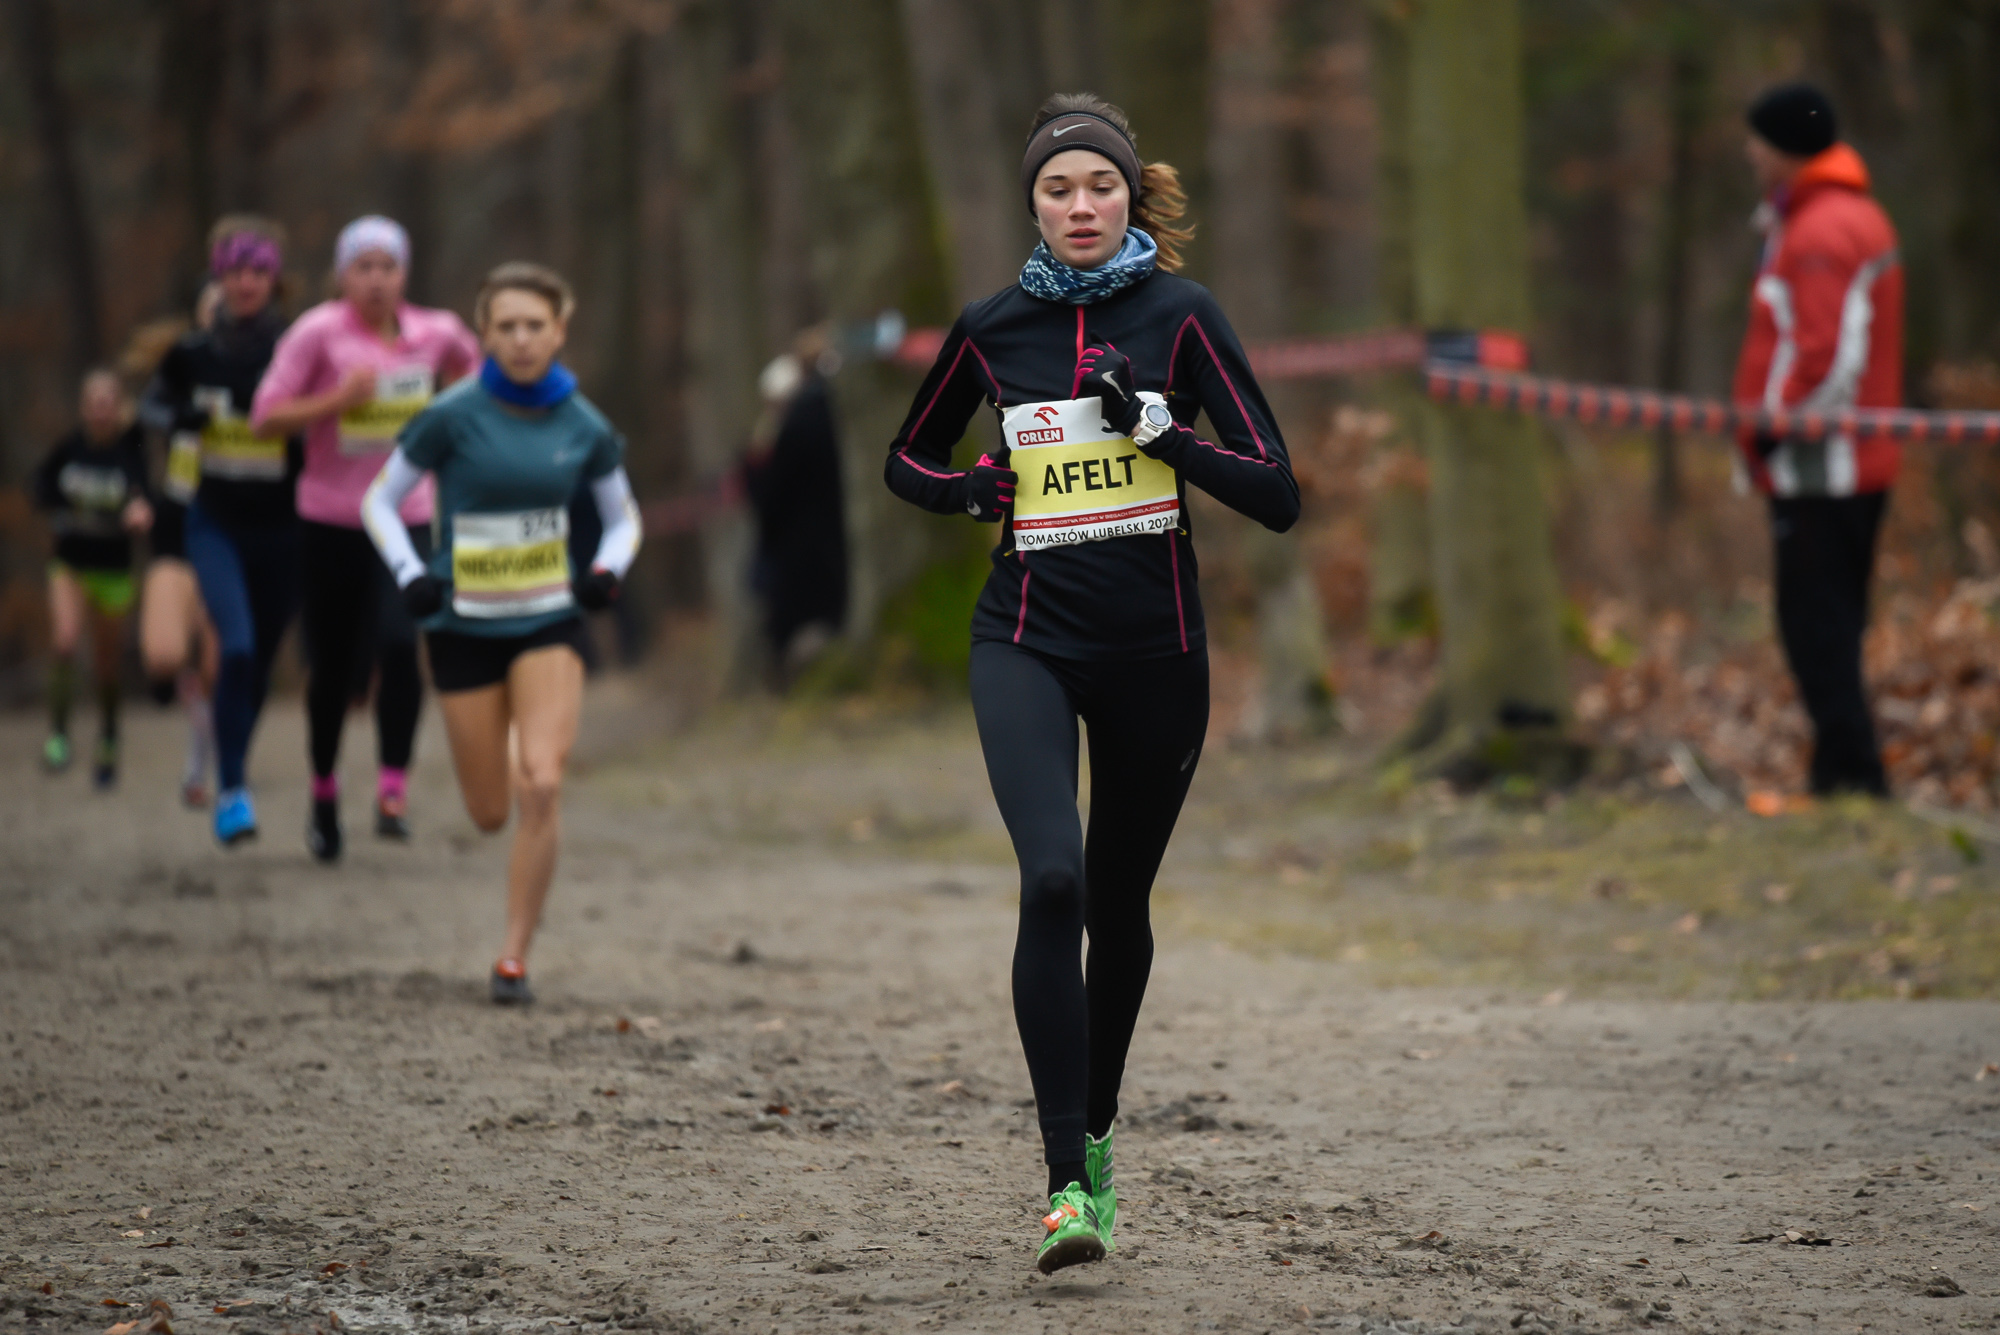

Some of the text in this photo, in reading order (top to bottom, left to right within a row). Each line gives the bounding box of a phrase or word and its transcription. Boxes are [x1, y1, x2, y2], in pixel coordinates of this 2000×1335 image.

[1020, 429, 1061, 443] ORLEN
[1042, 454, 1137, 495] AFELT
[1021, 529, 1088, 545] TOMASZÓW
[1093, 522, 1145, 538] LUBELSKI
